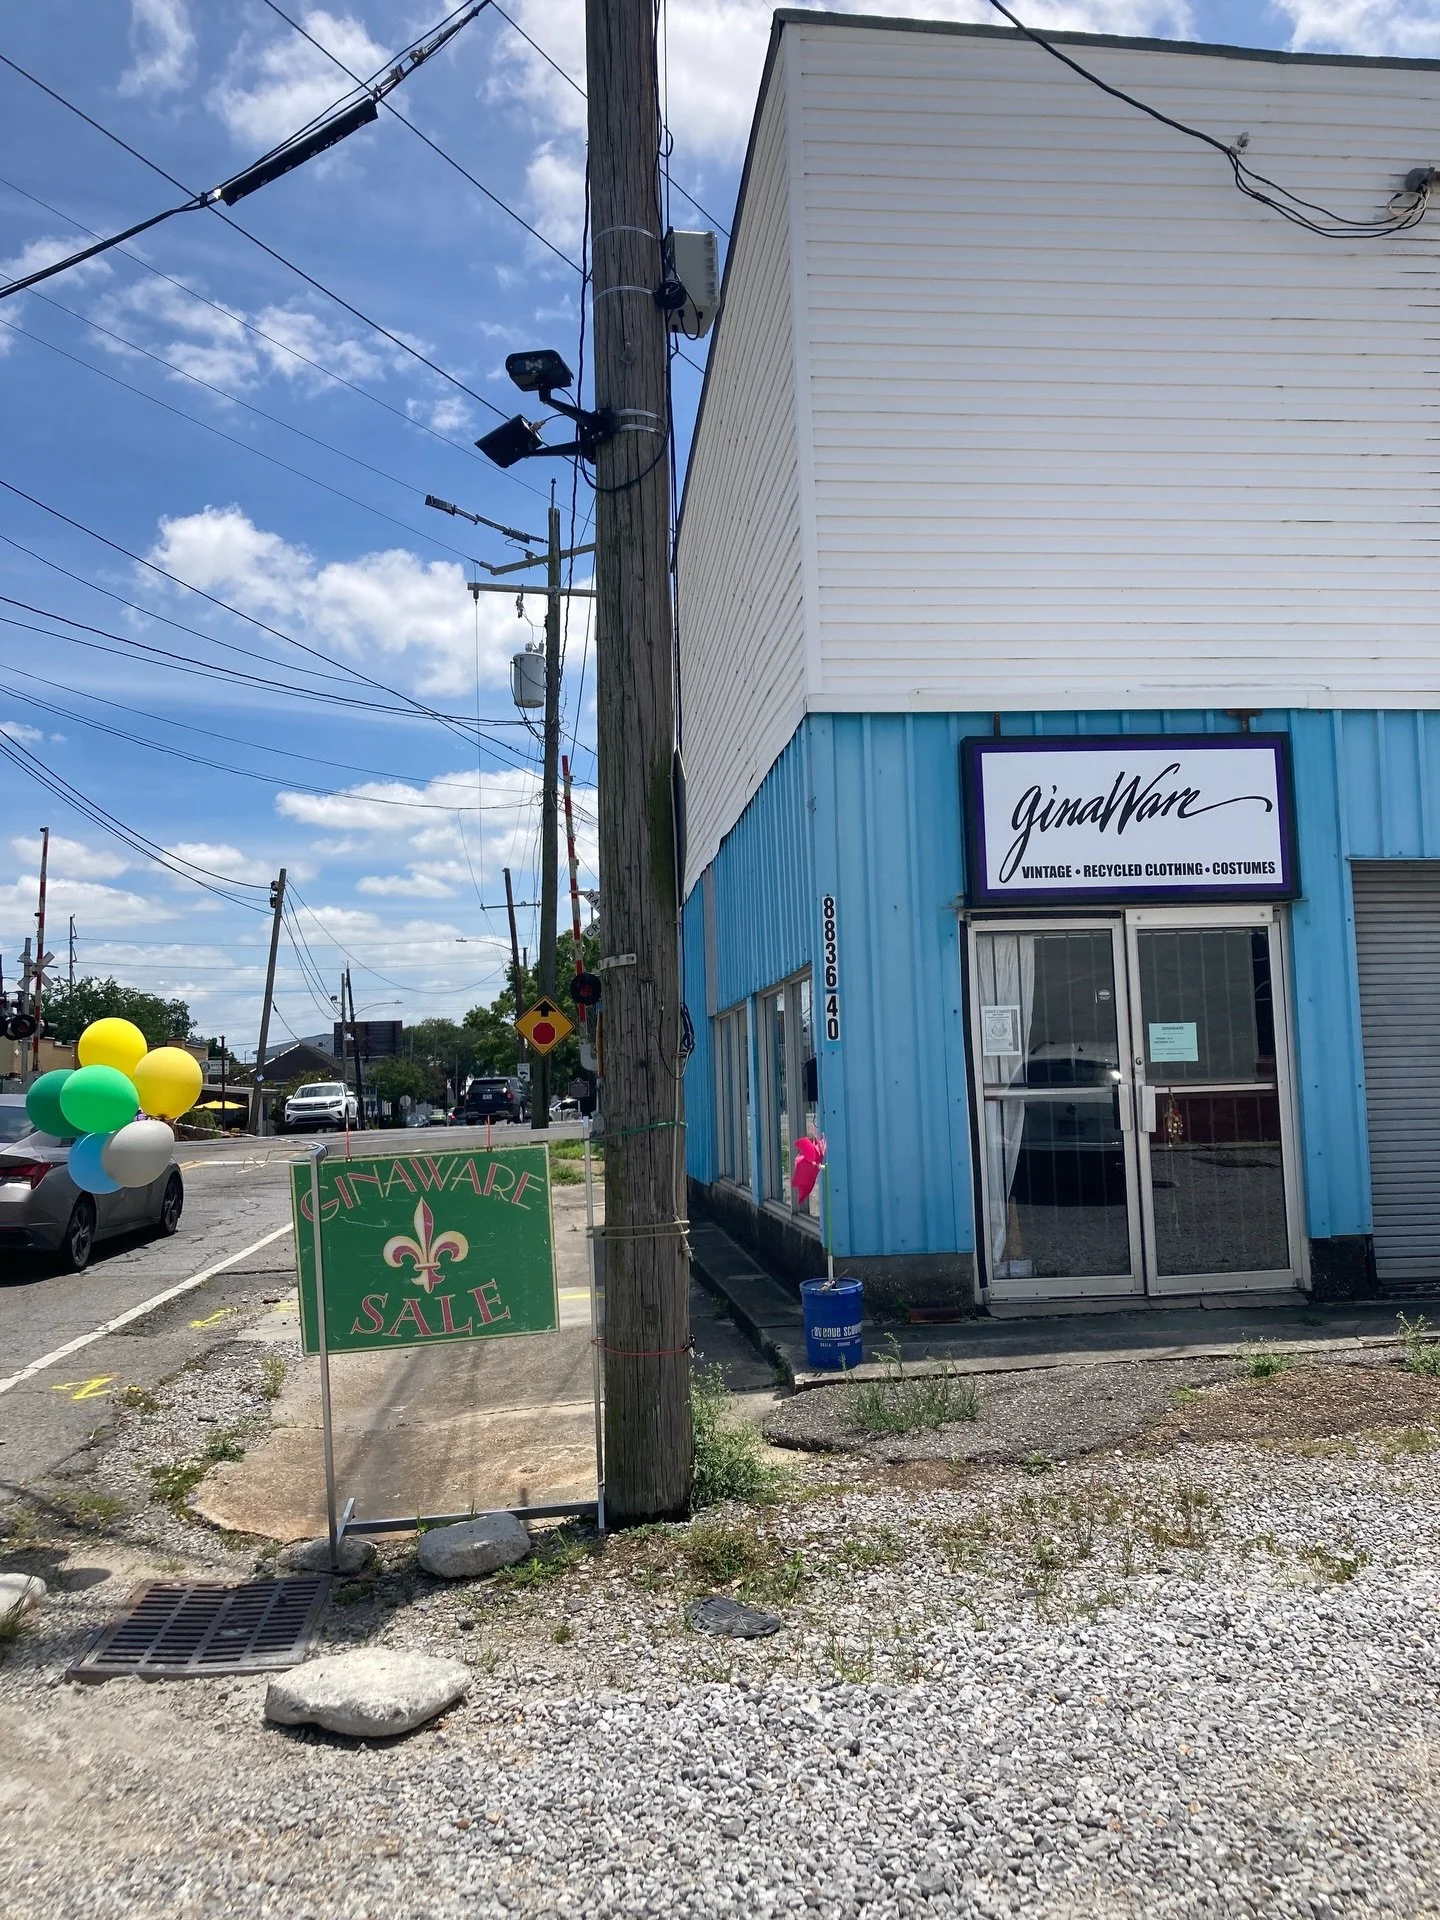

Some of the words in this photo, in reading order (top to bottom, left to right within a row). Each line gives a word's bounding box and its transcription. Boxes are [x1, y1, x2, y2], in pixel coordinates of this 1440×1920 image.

[999, 763, 1272, 884] ginaWare
[1021, 865, 1072, 879] VINTAGE
[1083, 864, 1142, 878] RECYCLED
[1145, 863, 1203, 877] CLOTHING
[1212, 861, 1276, 875] COSTUMES
[300, 1156, 545, 1223] GINAWARE
[350, 1278, 512, 1337] SALE
